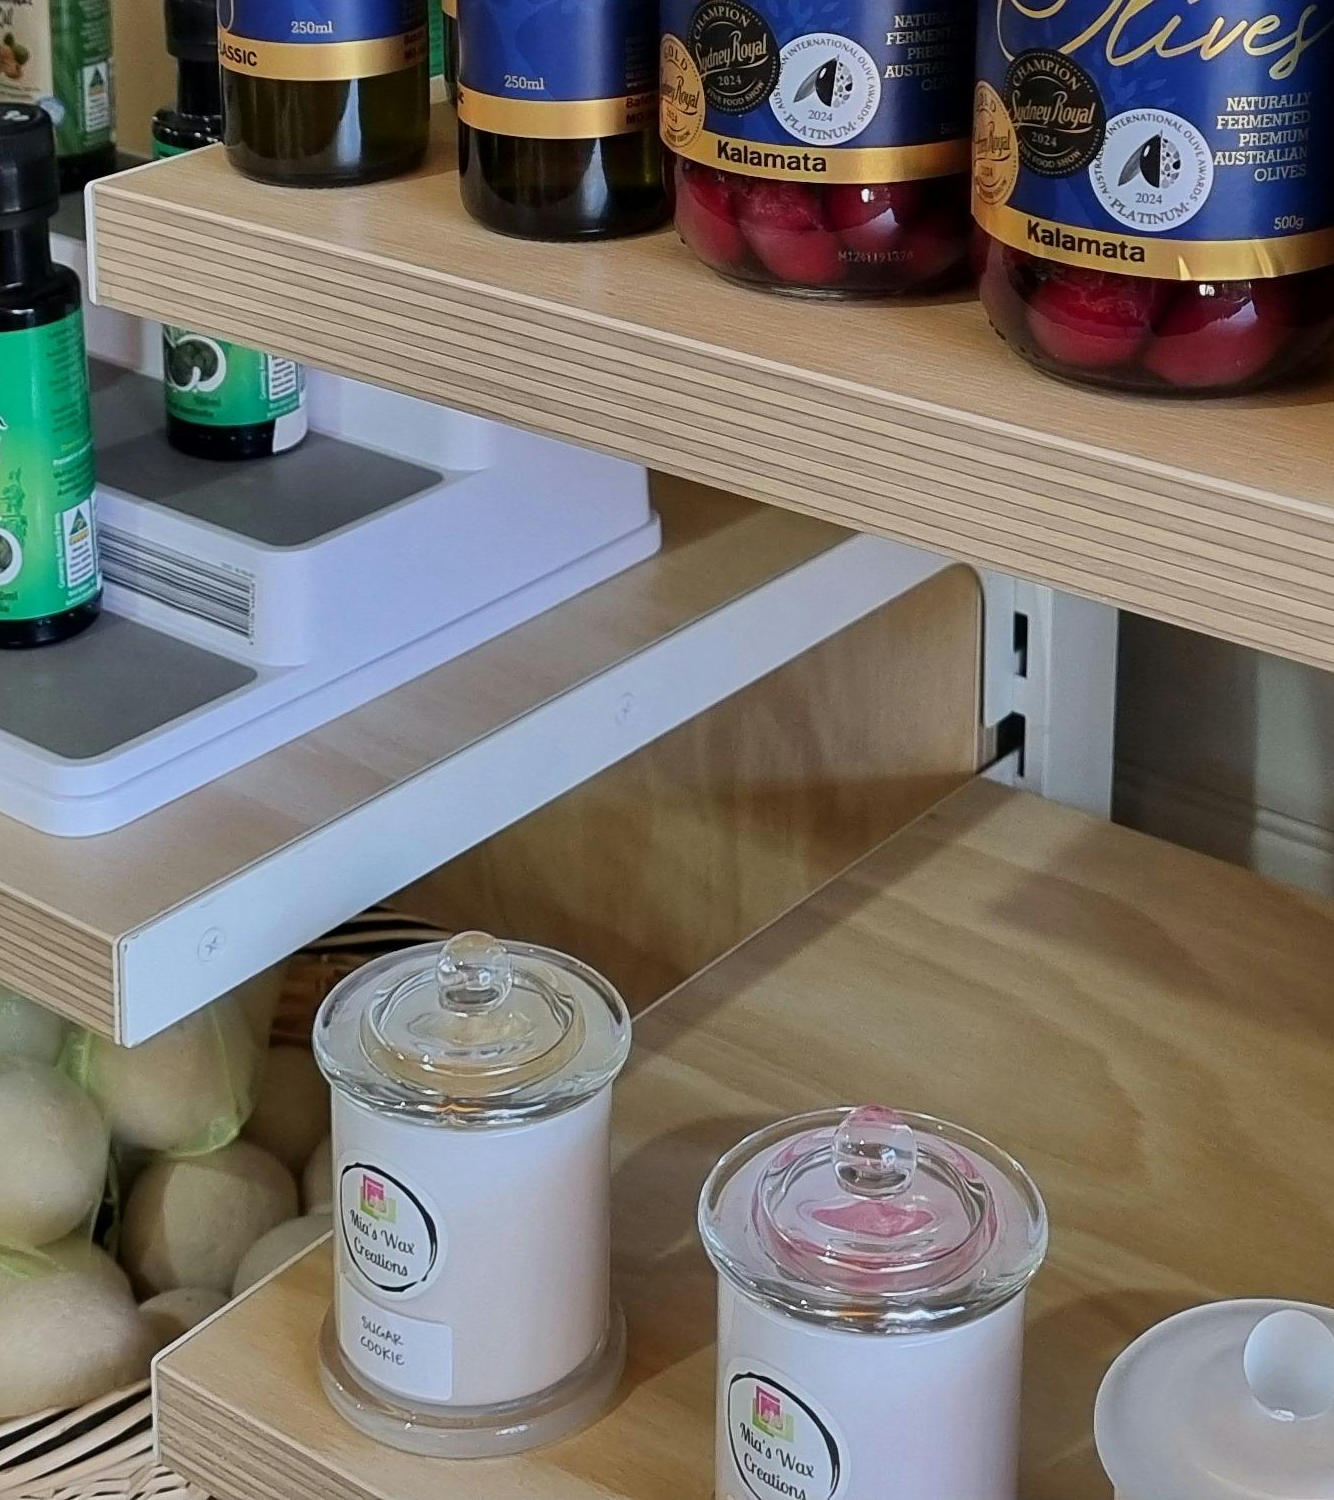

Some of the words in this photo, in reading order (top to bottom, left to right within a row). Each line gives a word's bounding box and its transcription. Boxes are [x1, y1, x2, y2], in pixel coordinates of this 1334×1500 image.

[291, 19, 333, 35] 250ml
[693, 5, 751, 41] CHAMPION
[216, 43, 258, 68] LASSIC
[694, 42, 731, 72] Sydney
[729, 30, 768, 64] Royal
[787, 37, 858, 59] INTERNATIONAL
[504, 74, 545, 91] 250ml
[718, 74, 742, 87] 2024
[857, 55, 875, 86] OLIVE
[1012, 58, 1081, 92] CHAMPION
[807, 109, 833, 122] 2024
[857, 84, 876, 123] AWARDS
[1008, 89, 1051, 127] Sydney
[1050, 90, 1097, 130] Royal
[1226, 92, 1313, 112] NATURALLY
[784, 113, 857, 141] PLATINUM
[1106, 112, 1183, 137] INTERNATIONAL
[1216, 110, 1311, 130] FERMENTED
[1030, 131, 1058, 148] 2024
[1182, 129, 1205, 160] OLIVE
[1238, 128, 1309, 148] PREMIUM
[717, 139, 828, 173] Kalamata
[1213, 146, 1309, 166] AUSTRALIAN
[1188, 158, 1208, 203] AWARDS
[1254, 164, 1308, 183] OLIVES
[1109, 198, 1189, 226] PLATINUM
[1134, 192, 1163, 206] 2024
[1273, 215, 1305, 233] 500g
[1026, 219, 1146, 263] Kalamata
[349, 1208, 378, 1241] Mia's
[380, 1229, 416, 1256] Wax
[353, 1236, 409, 1278] Creations
[361, 1315, 405, 1347] SUGAR
[360, 1335, 406, 1367] COOKIE
[738, 1421, 773, 1460] Mia's
[775, 1447, 815, 1479] Wax
[742, 1452, 807, 1500] Creations
